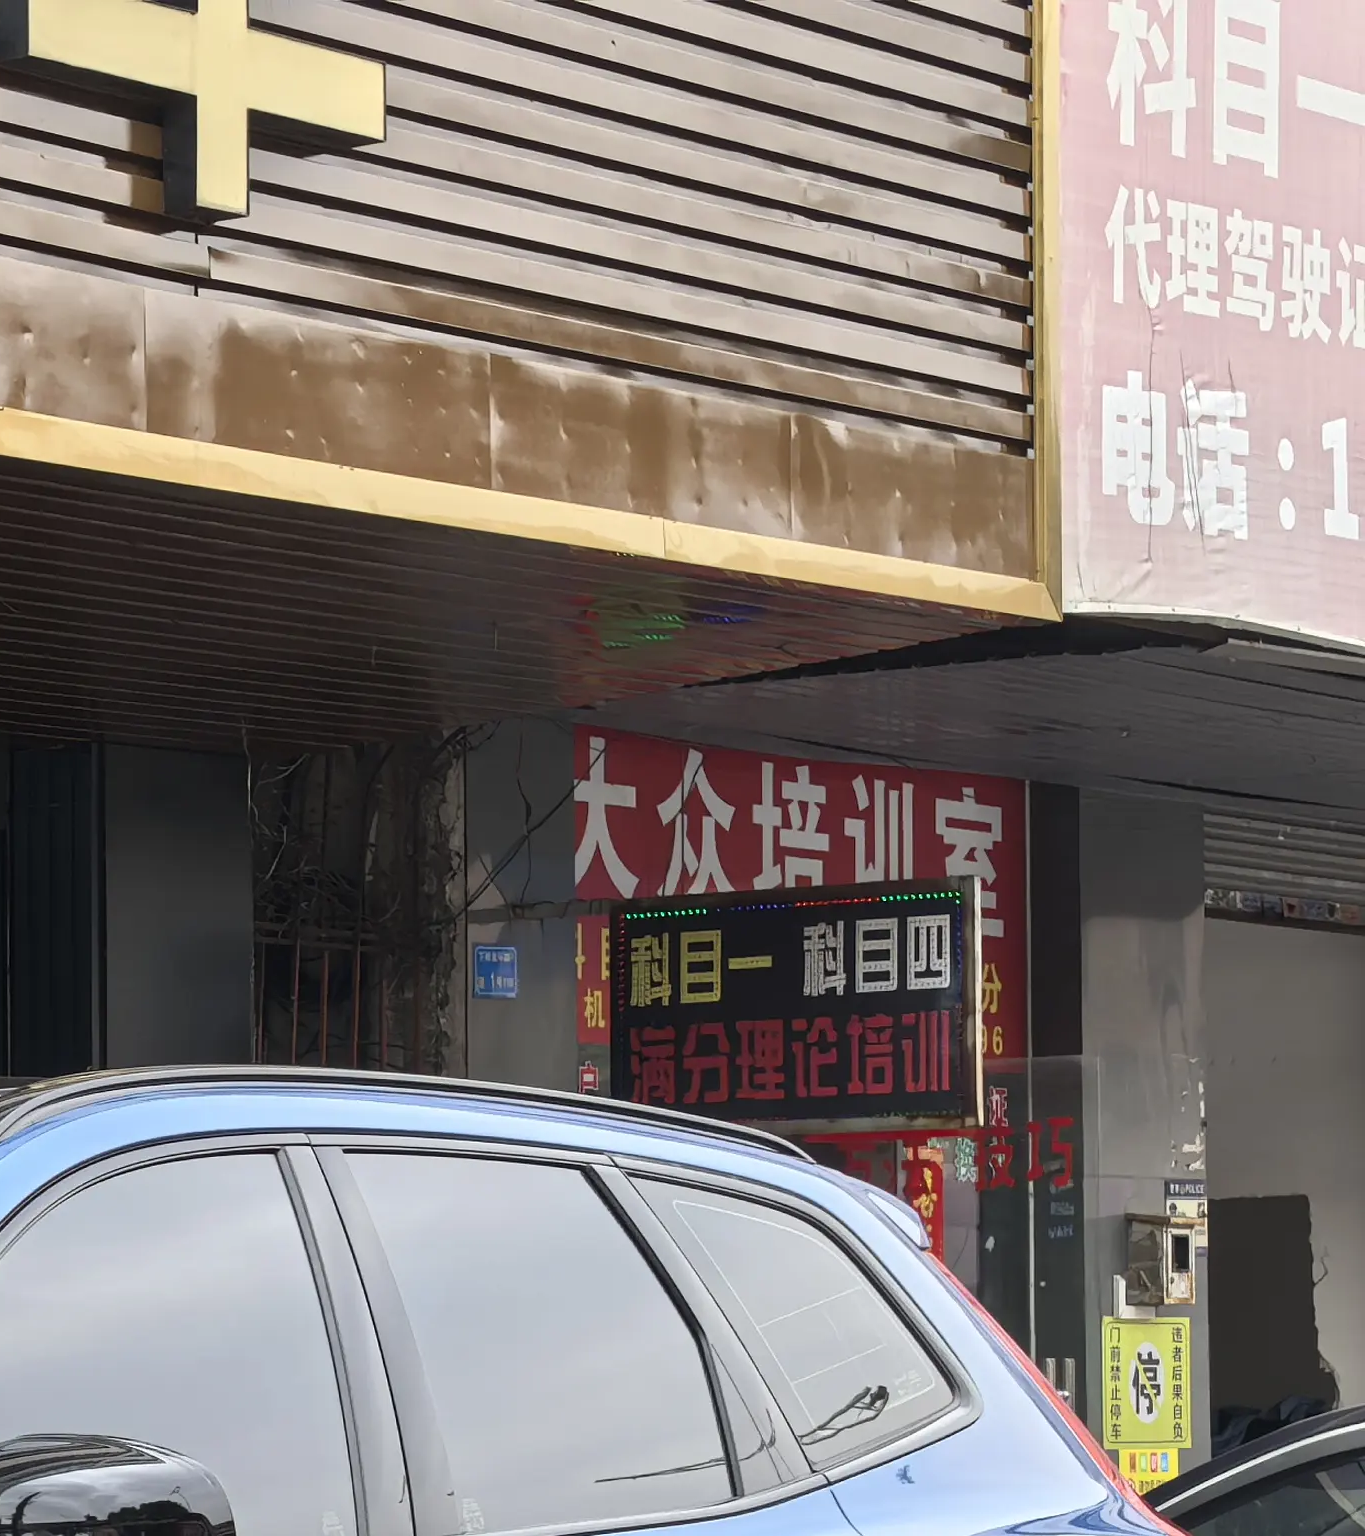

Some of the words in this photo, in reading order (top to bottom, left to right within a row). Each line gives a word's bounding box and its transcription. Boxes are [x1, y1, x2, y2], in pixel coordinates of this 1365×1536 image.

[573, 737, 1004, 938] 大众培训室
[629, 930, 773, 1007] 科目一
[802, 914, 951, 997] 科目四
[630, 1010, 951, 1104] 满分理论培训
[1109, 1326, 1121, 1440] 门前禁止停车
[1131, 1350, 1161, 1415] 停
[1171, 1326, 1183, 1440] 违者后果自负
